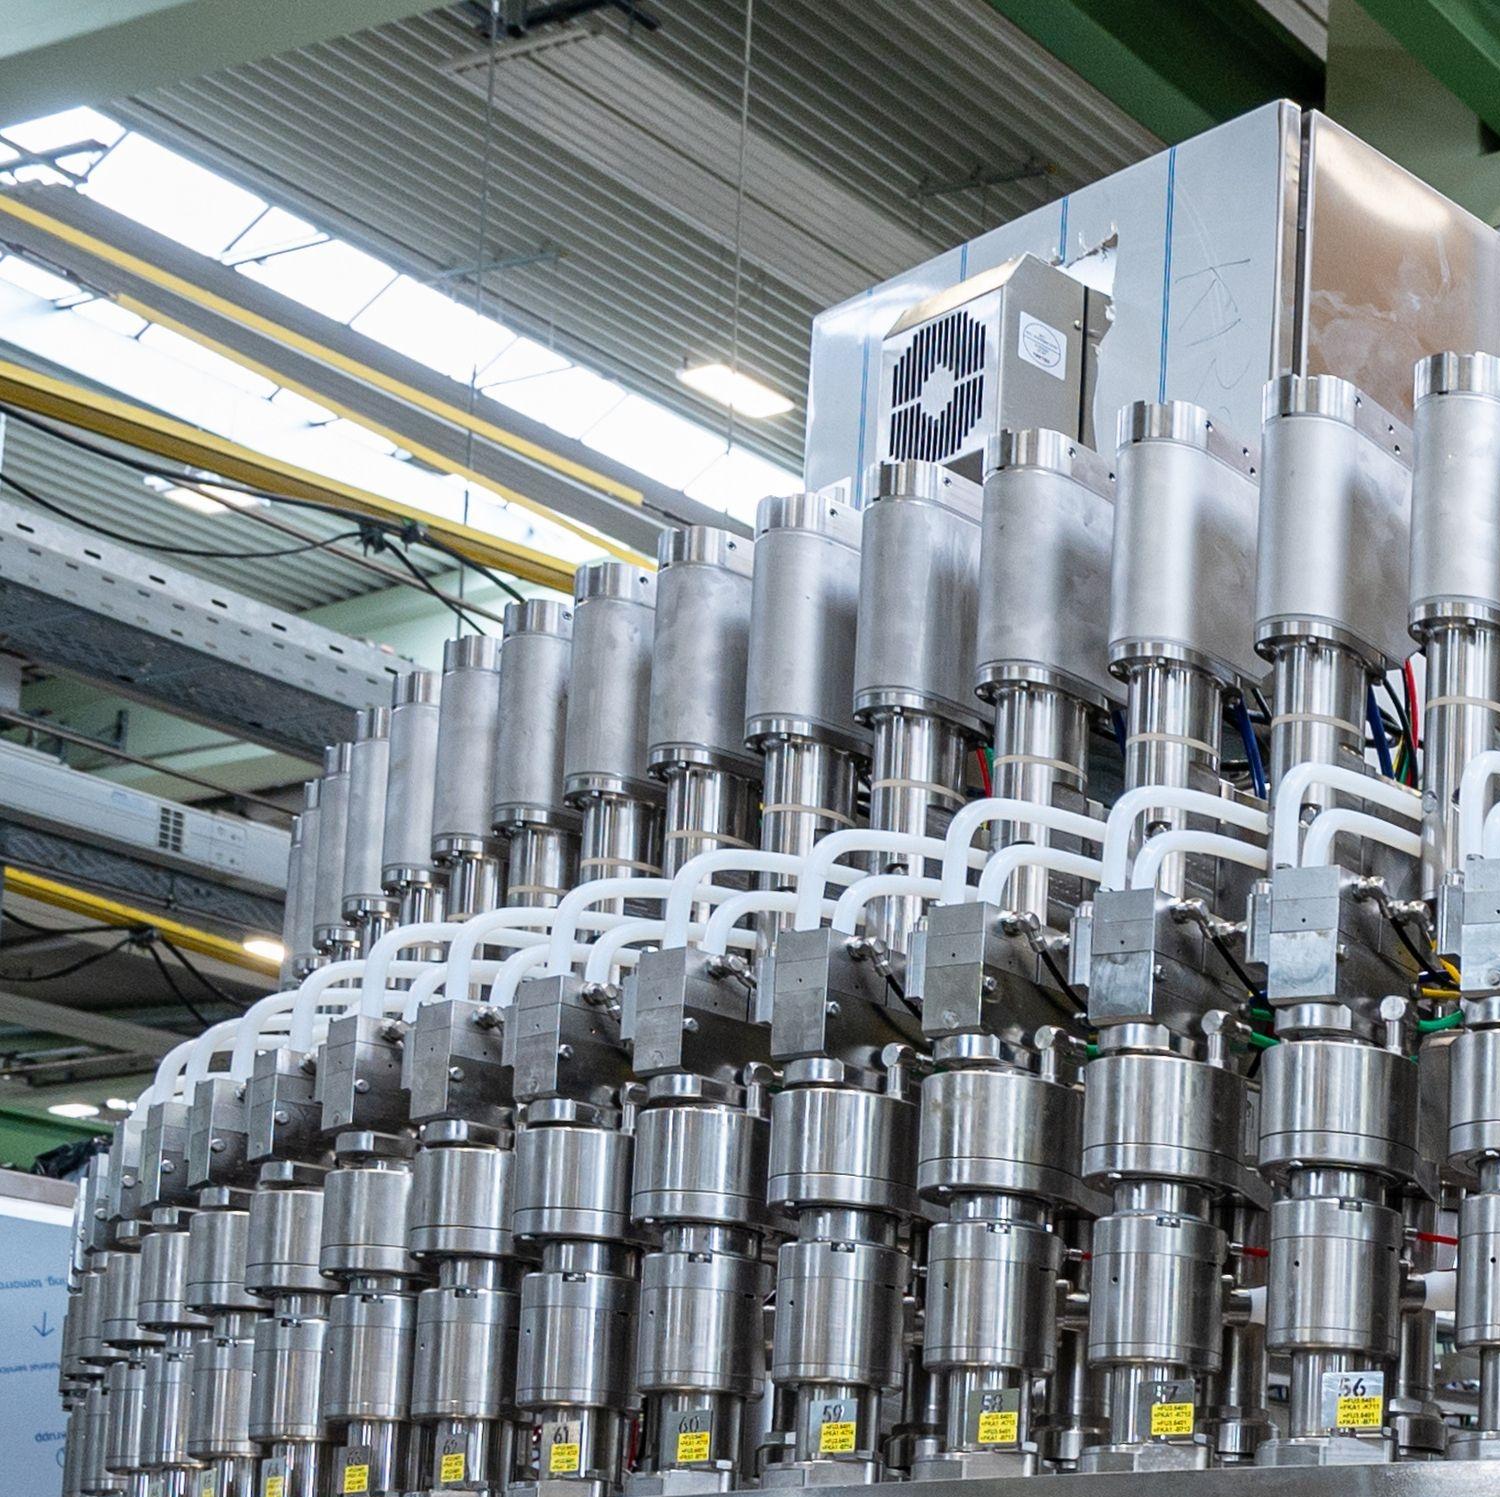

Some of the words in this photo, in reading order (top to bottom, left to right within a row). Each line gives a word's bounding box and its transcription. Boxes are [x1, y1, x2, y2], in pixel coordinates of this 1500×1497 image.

[1339, 1378, 1365, 1396] 56
[823, 1404, 842, 1423] 59
[679, 1416, 699, 1433] 60
[554, 1426, 568, 1443] 61
